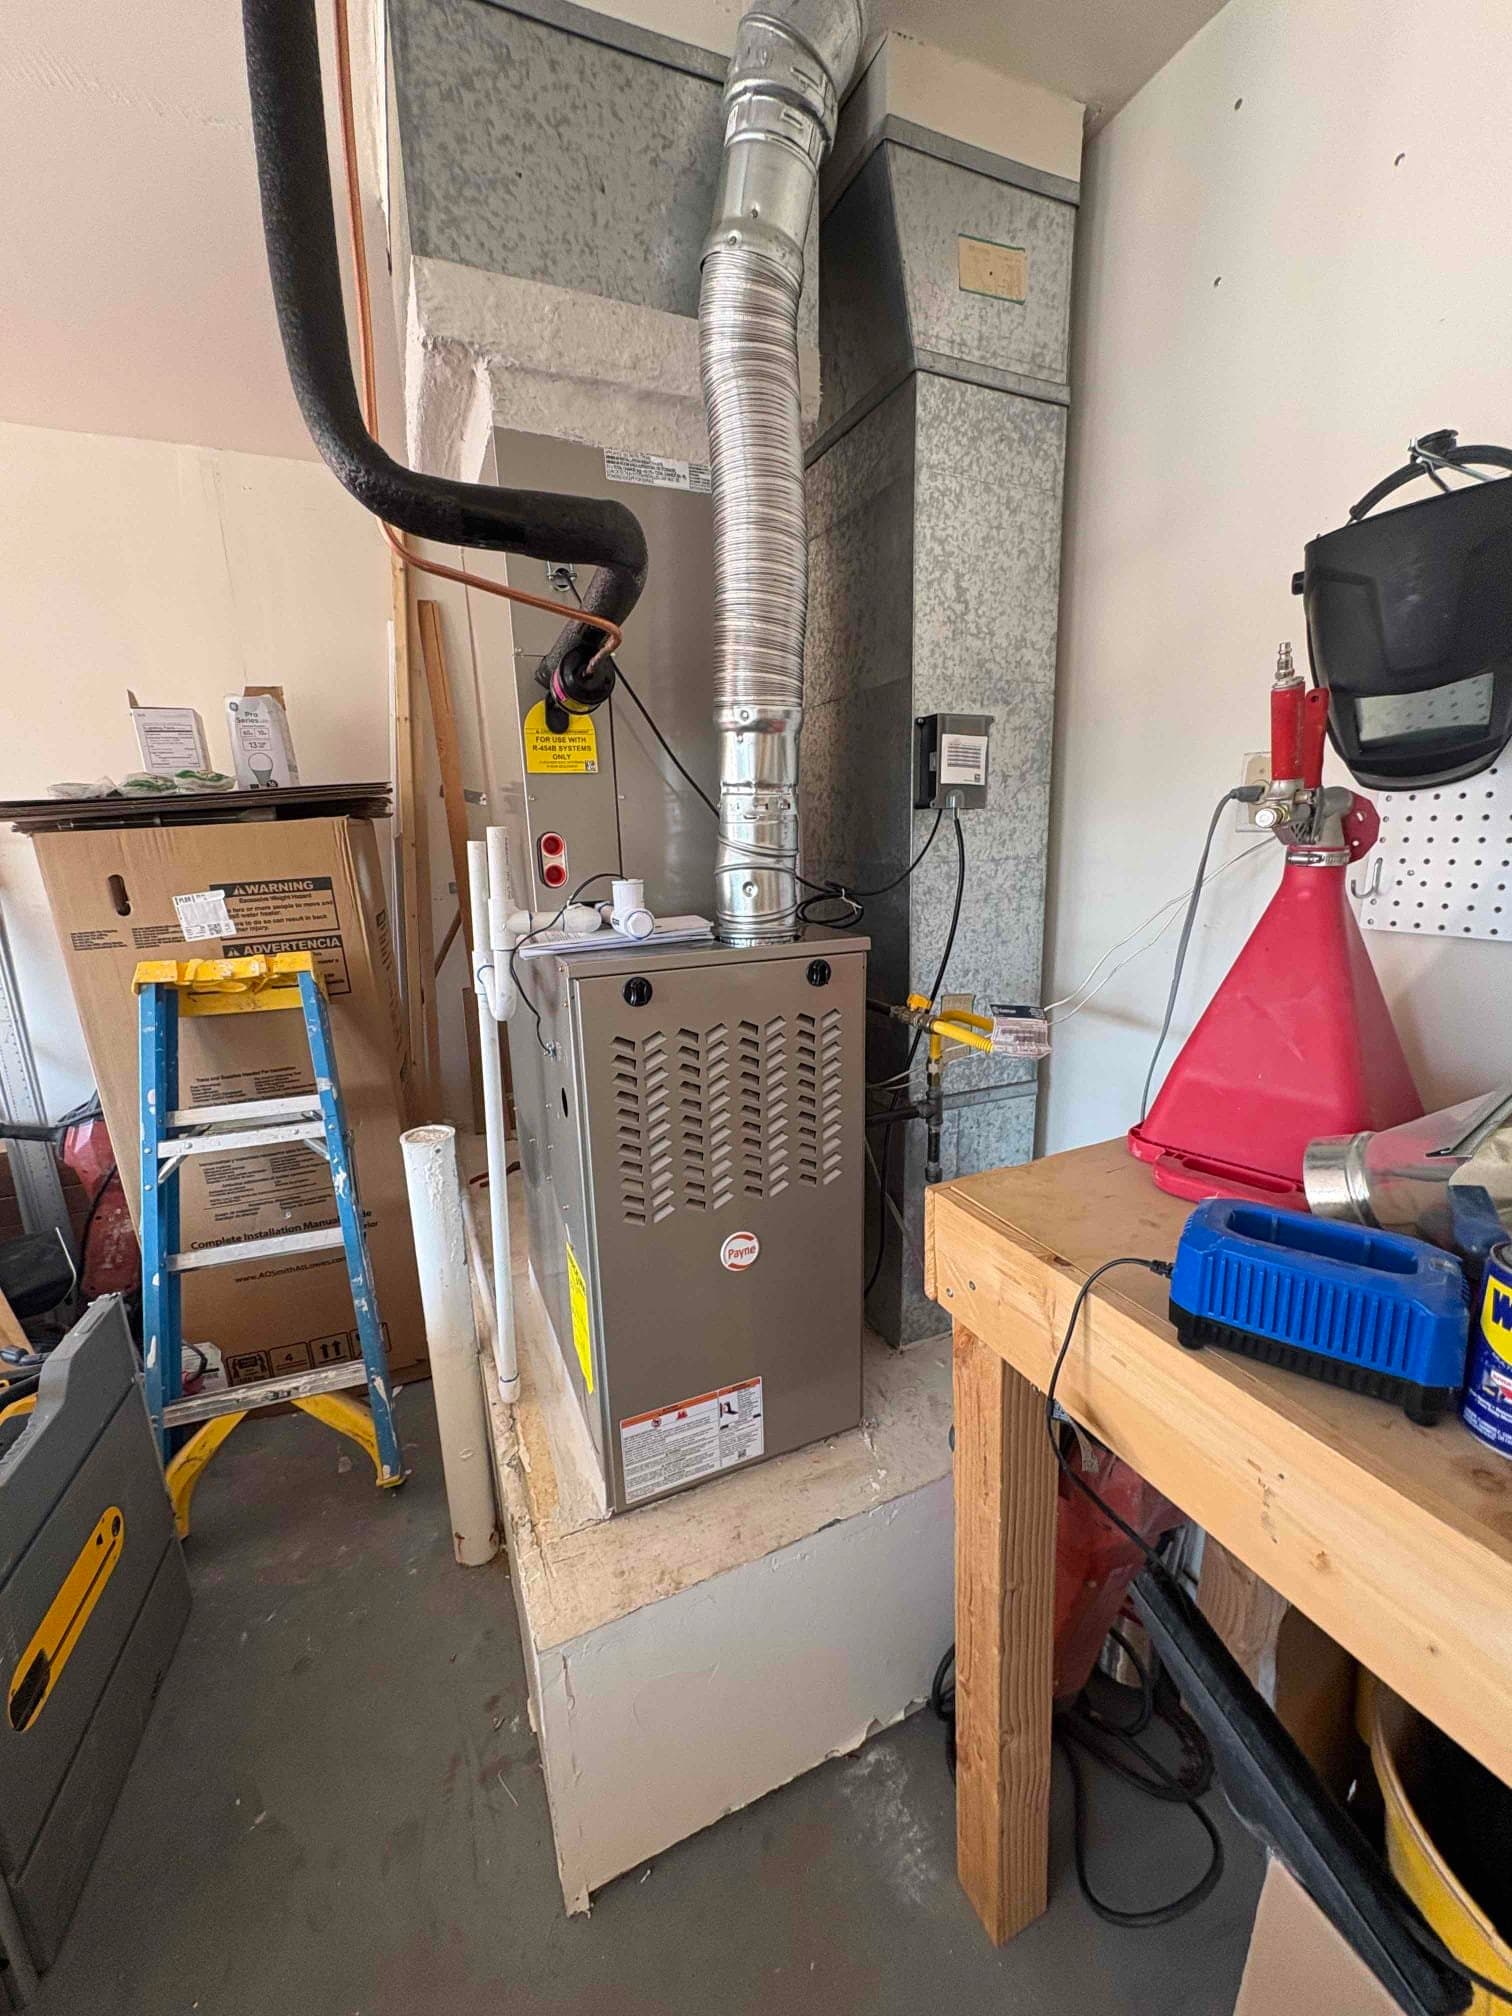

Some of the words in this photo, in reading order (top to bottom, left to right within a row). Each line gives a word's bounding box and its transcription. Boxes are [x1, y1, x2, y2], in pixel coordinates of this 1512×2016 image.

[244, 881, 314, 894] WARNING
[243, 937, 341, 956] ADVERTENCIA
[190, 1236, 242, 1249] Complete
[243, 1223, 303, 1241] Installation
[303, 1216, 340, 1230] Manual
[728, 1246, 756, 1260] Payne
